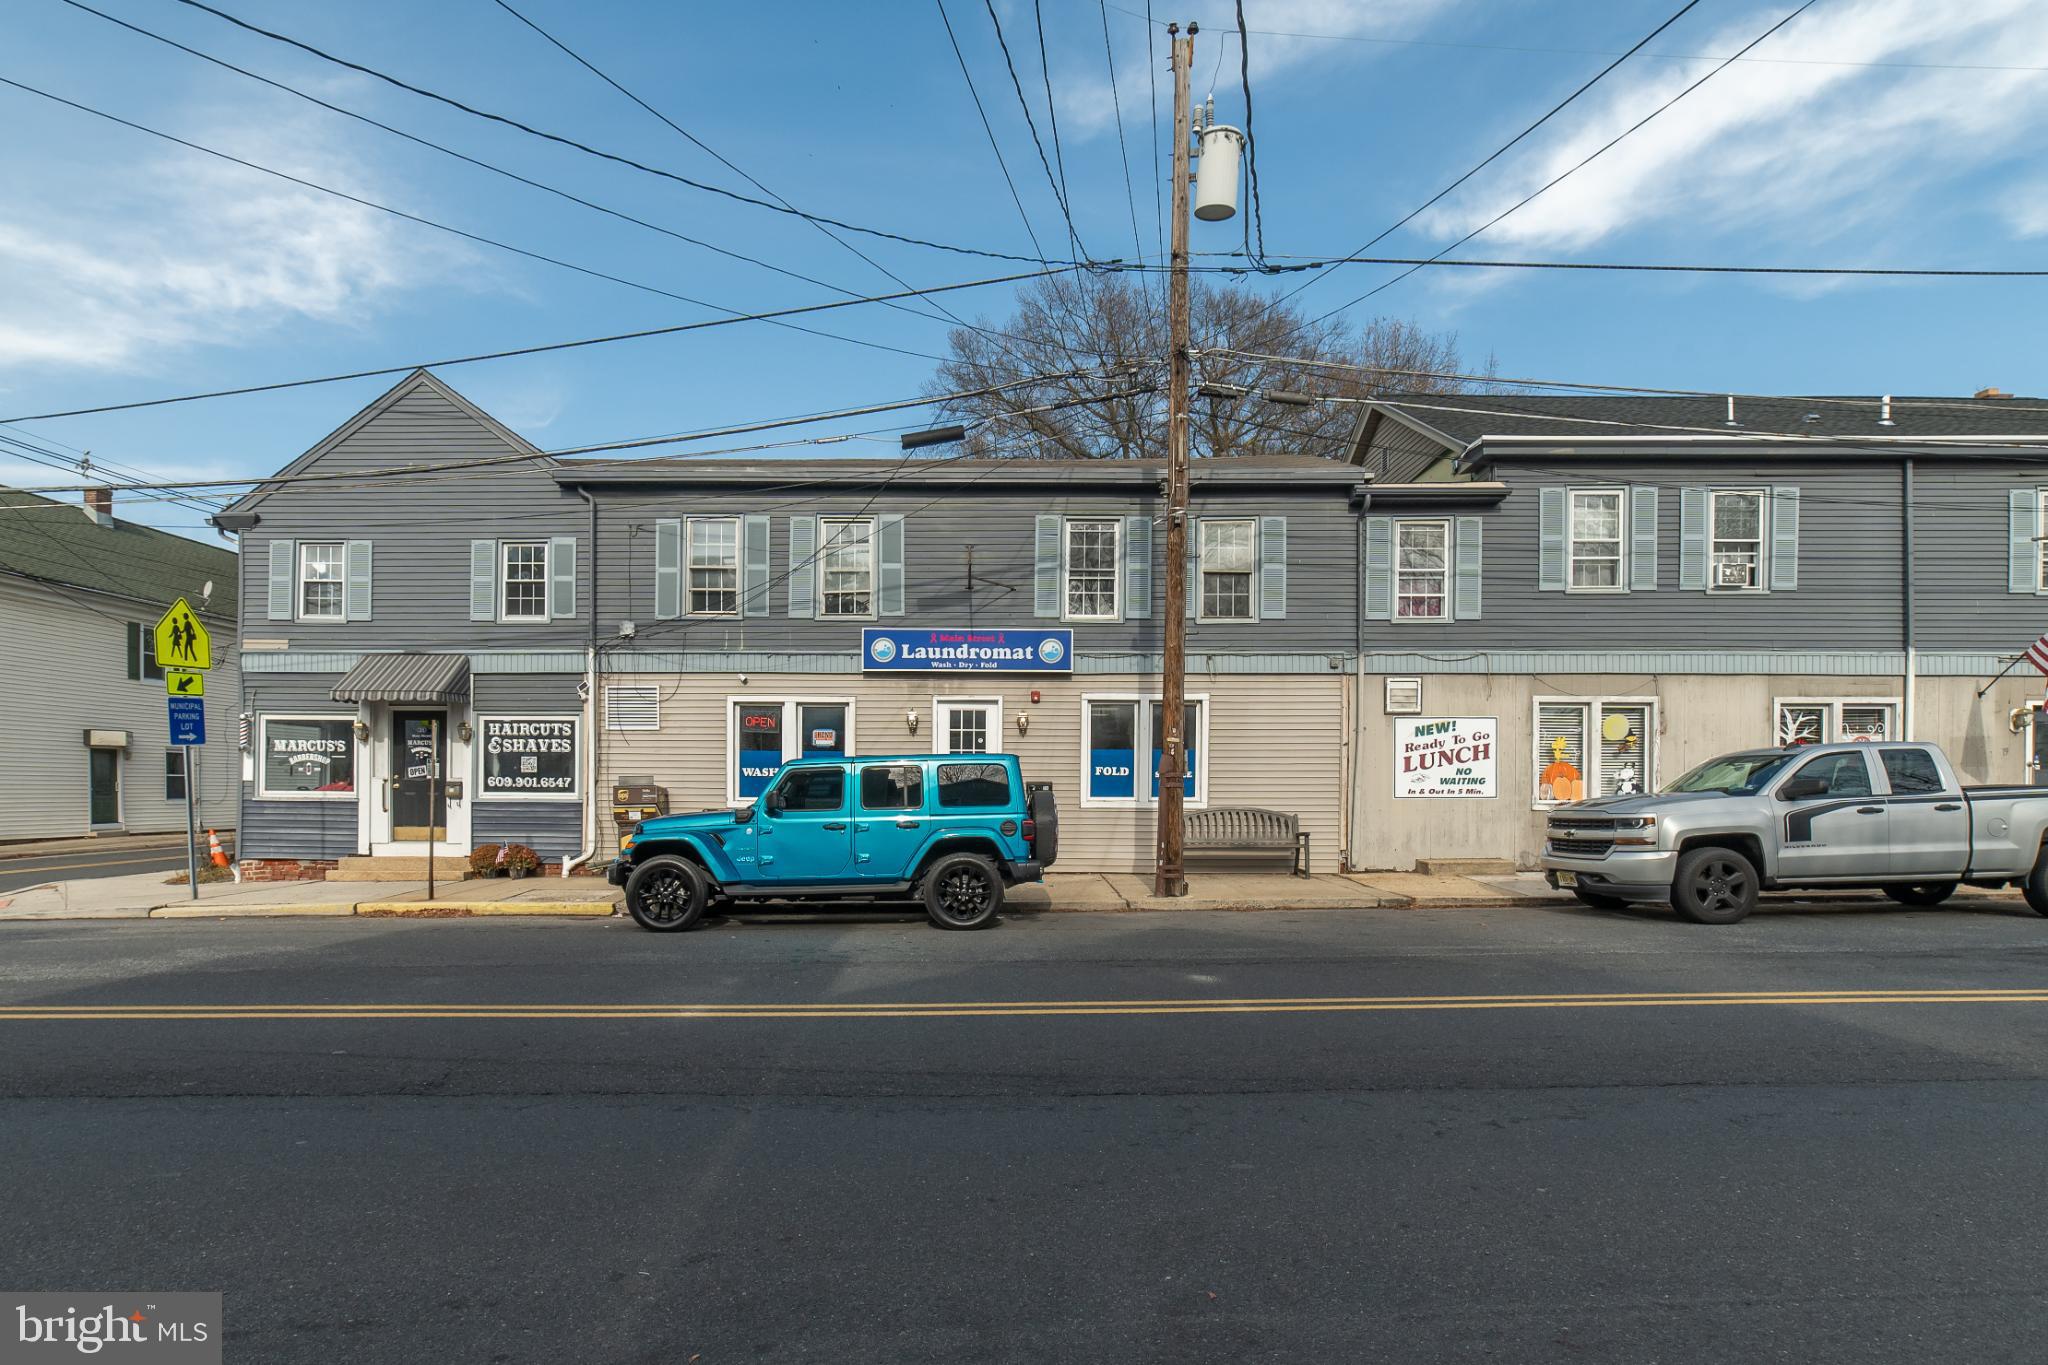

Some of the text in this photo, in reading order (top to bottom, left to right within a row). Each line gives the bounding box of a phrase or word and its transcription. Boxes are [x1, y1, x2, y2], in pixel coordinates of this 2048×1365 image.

[901, 644, 1033, 660] Laundromat
[958, 661, 973, 670] Dry
[980, 661, 997, 669] Fold
[170, 702, 202, 711] MUNICIPAL
[173, 712, 199, 721] PARKING
[745, 715, 776, 729] OPEN
[180, 722, 193, 731] LOT
[488, 722, 572, 736] HAIRCUTS
[1414, 720, 1457, 738] NEW!
[273, 739, 346, 752] MARCUS'S
[1404, 731, 1490, 753] Ready To Go
[1402, 742, 1491, 773] LUNCH
[409, 767, 426, 776] OPEN
[1095, 766, 1130, 776] FOLD
[1455, 767, 1472, 776] NO
[487, 776, 572, 788] 609.901.6547
[1439, 777, 1486, 785] WAITING
